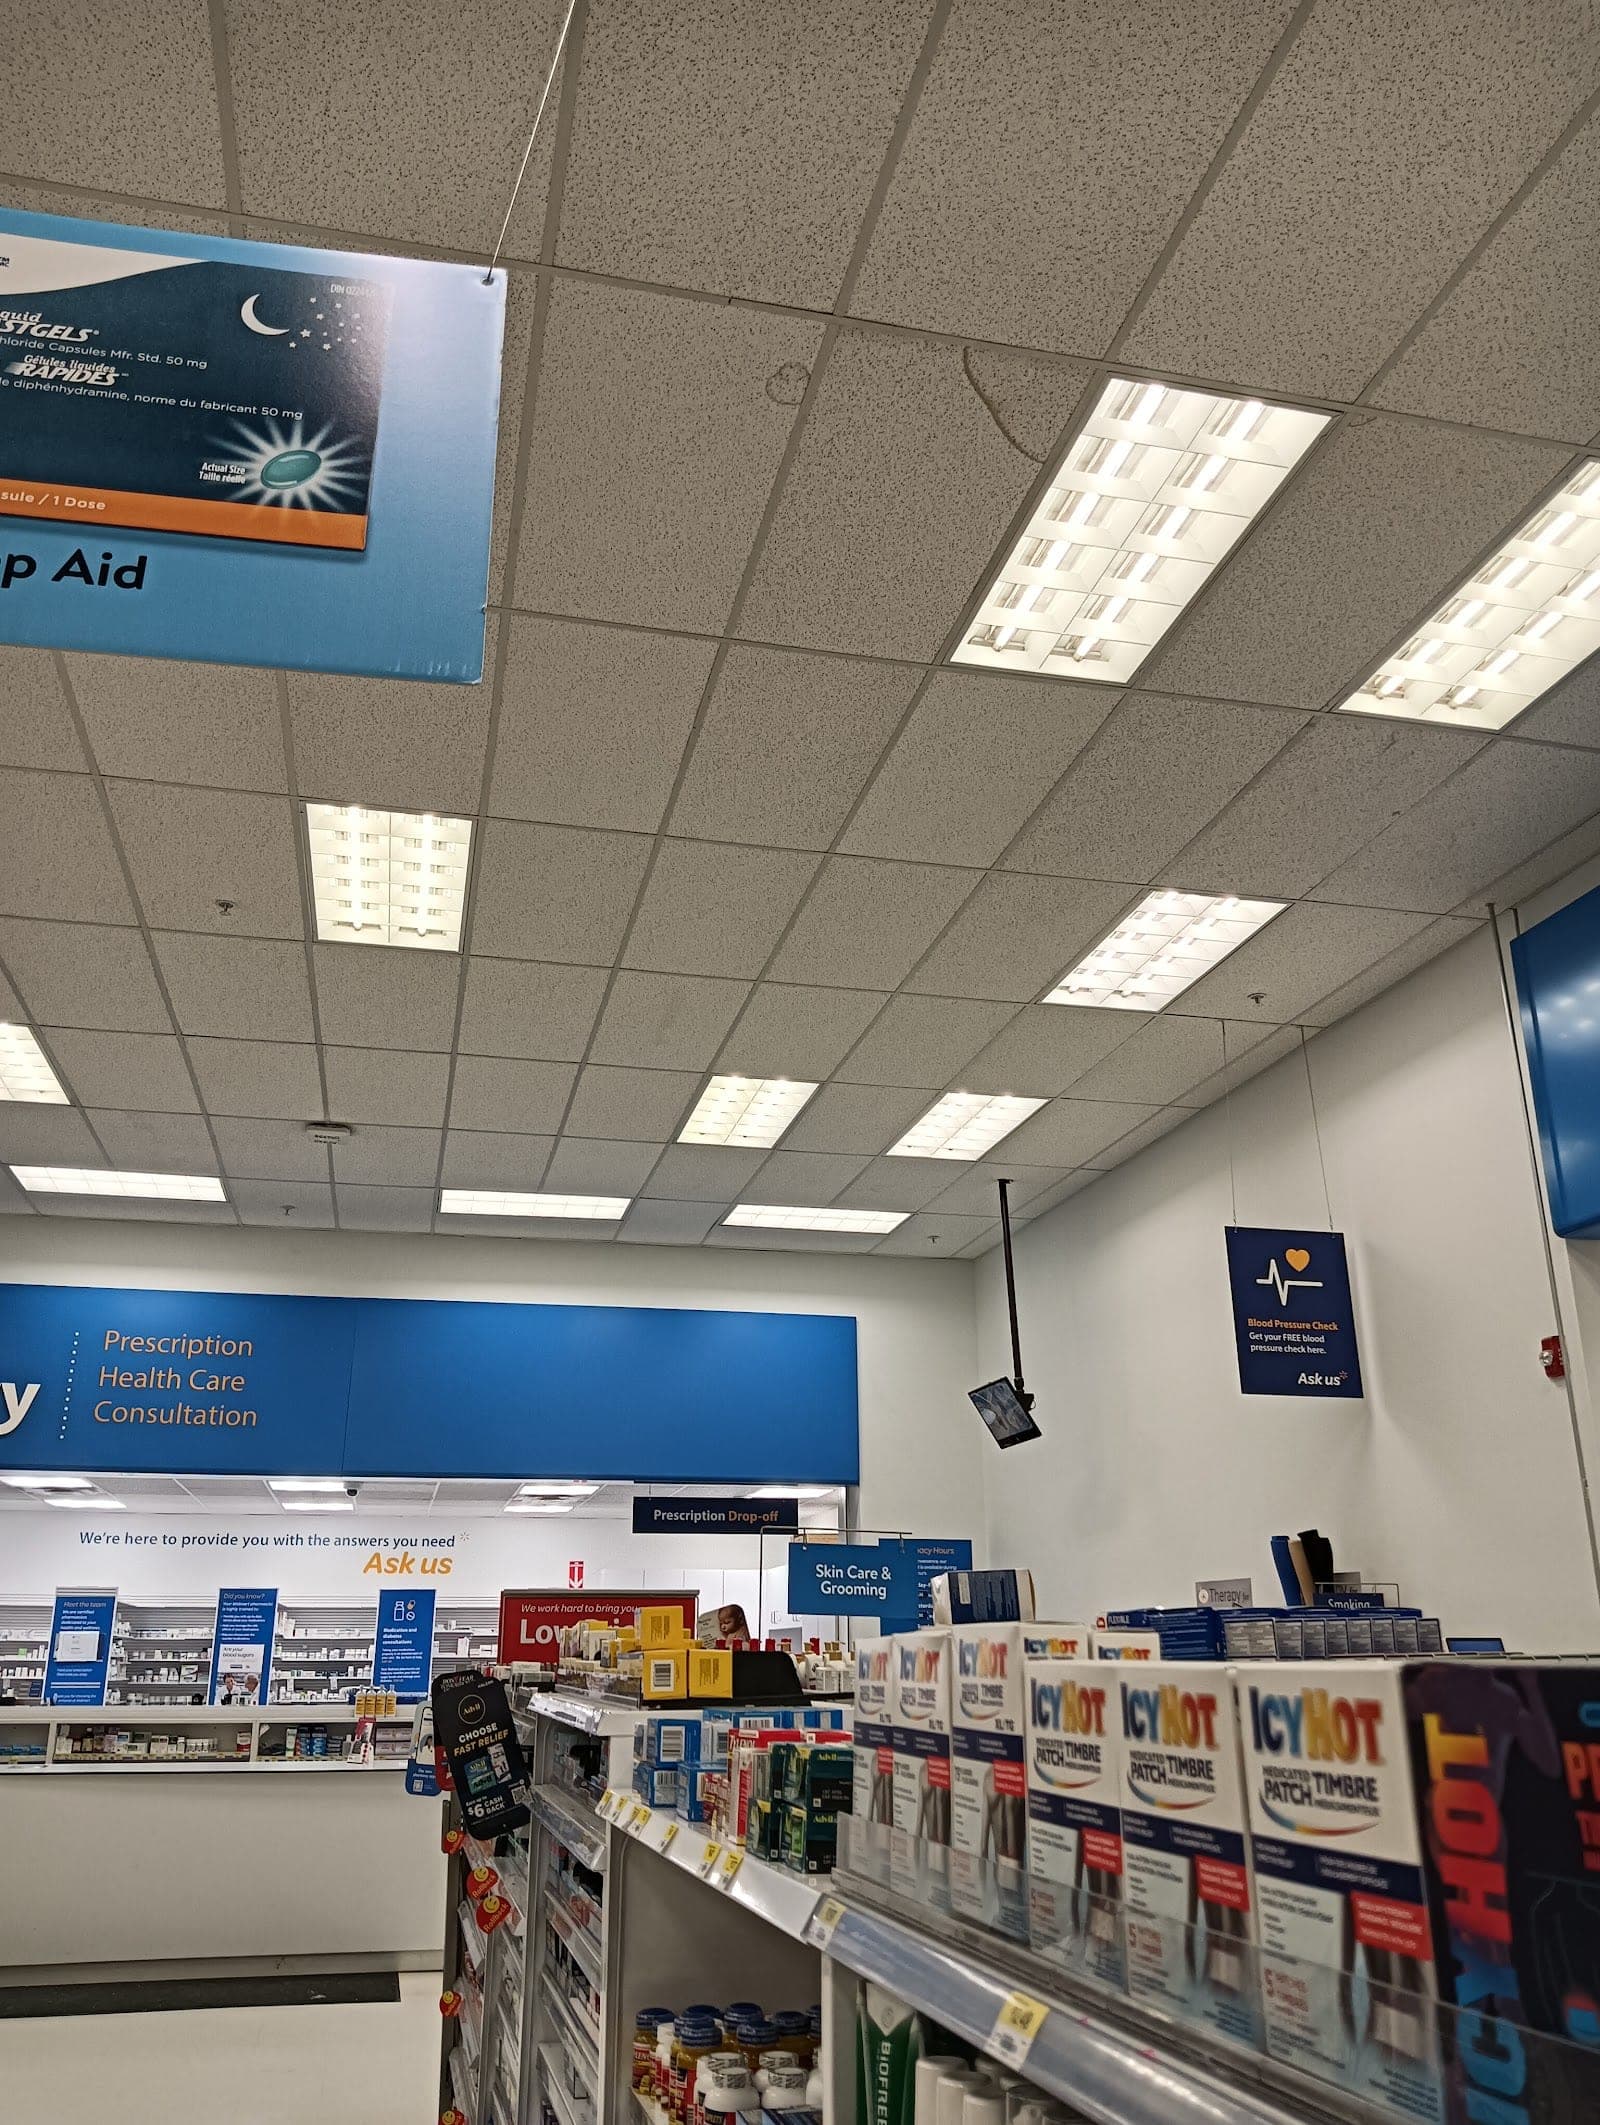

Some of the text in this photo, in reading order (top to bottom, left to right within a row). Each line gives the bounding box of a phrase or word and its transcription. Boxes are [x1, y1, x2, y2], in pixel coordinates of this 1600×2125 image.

[24, 354, 116, 373] Gélules liquides
[49, 342, 106, 358] Capsules
[110, 350, 133, 360] Mfr.
[138, 352, 162, 364] Std.
[166, 356, 183, 366] 50
[187, 359, 208, 369] mg
[15, 363, 120, 386] RAPIDES
[13, 379, 130, 402] diphénhydramine,
[134, 394, 176, 407] norme
[179, 397, 197, 408] du
[200, 400, 257, 415] fabricant
[261, 406, 279, 417] 50
[282, 410, 303, 421] mg
[199, 471, 221, 482] Taille
[202, 462, 246, 475] Actual Size
[1, 491, 35, 504] sule
[53, 495, 60, 506] 1
[64, 496, 106, 510] Dose
[51, 548, 148, 590] Aid
[1247, 1318, 1338, 1331] Blood Pressure Check
[104, 1330, 253, 1359] Prescription
[1249, 1332, 1325, 1343] Get your FREE blood
[1250, 1344, 1327, 1354] pressure check here.
[99, 1366, 245, 1392] Health Care
[1298, 1372, 1341, 1386] Ask us
[93, 1401, 257, 1427] Consultation
[653, 1509, 779, 1523] Prescription Drop-off
[79, 1531, 455, 1550] We're here to provide you with the answers you need
[363, 1552, 453, 1575] Ask us
[815, 1564, 892, 1580] Skin Care &
[820, 1581, 887, 1600] Grooming
[1209, 1588, 1240, 1604] Therapy
[521, 1604, 537, 1613] We
[538, 1604, 560, 1613] work
[561, 1604, 584, 1613] hard
[585, 1605, 595, 1613] to
[595, 1605, 620, 1615] bring
[458, 1722, 498, 1743] CHOOSE
[453, 1729, 509, 1757] FAST RELIEF
[1065, 1740, 1101, 1763] TIMBRE
[1036, 1747, 1065, 1767] PATCH
[1130, 1762, 1167, 1784] PATCH
[1166, 1755, 1214, 1780] TIMBRE
[1264, 1779, 1313, 1807] PATCH
[1312, 1771, 1379, 1801] TIMBRE
[467, 1803, 485, 1818] $6
[484, 1795, 503, 1808] CASH
[486, 1802, 505, 1814] BACK
